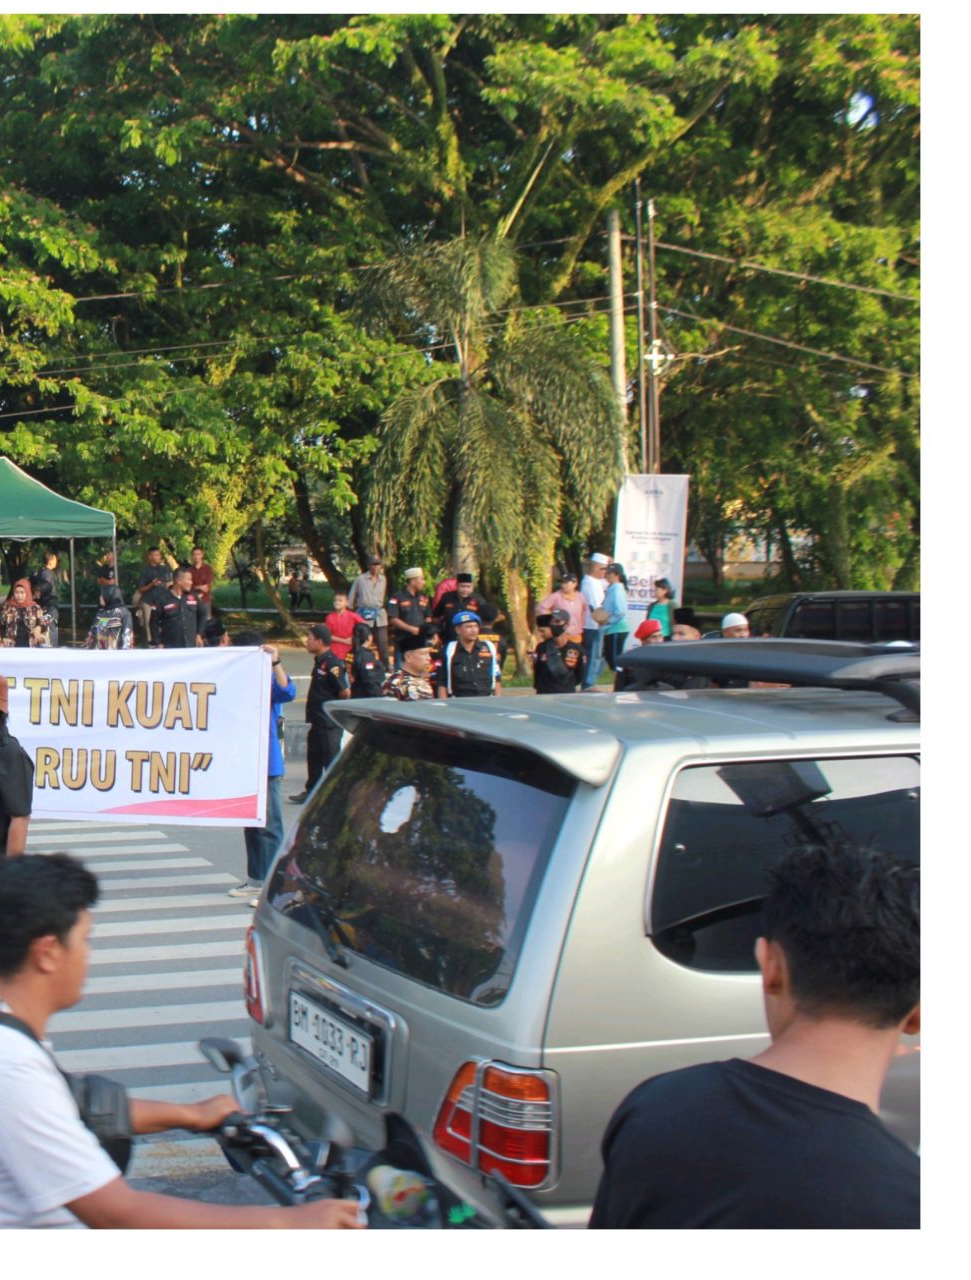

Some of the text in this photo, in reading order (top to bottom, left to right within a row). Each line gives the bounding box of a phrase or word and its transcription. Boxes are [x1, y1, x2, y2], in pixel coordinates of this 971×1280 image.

[24, 677, 95, 728] TNI
[106, 680, 217, 732] KUAT
[35, 746, 117, 793] RUU
